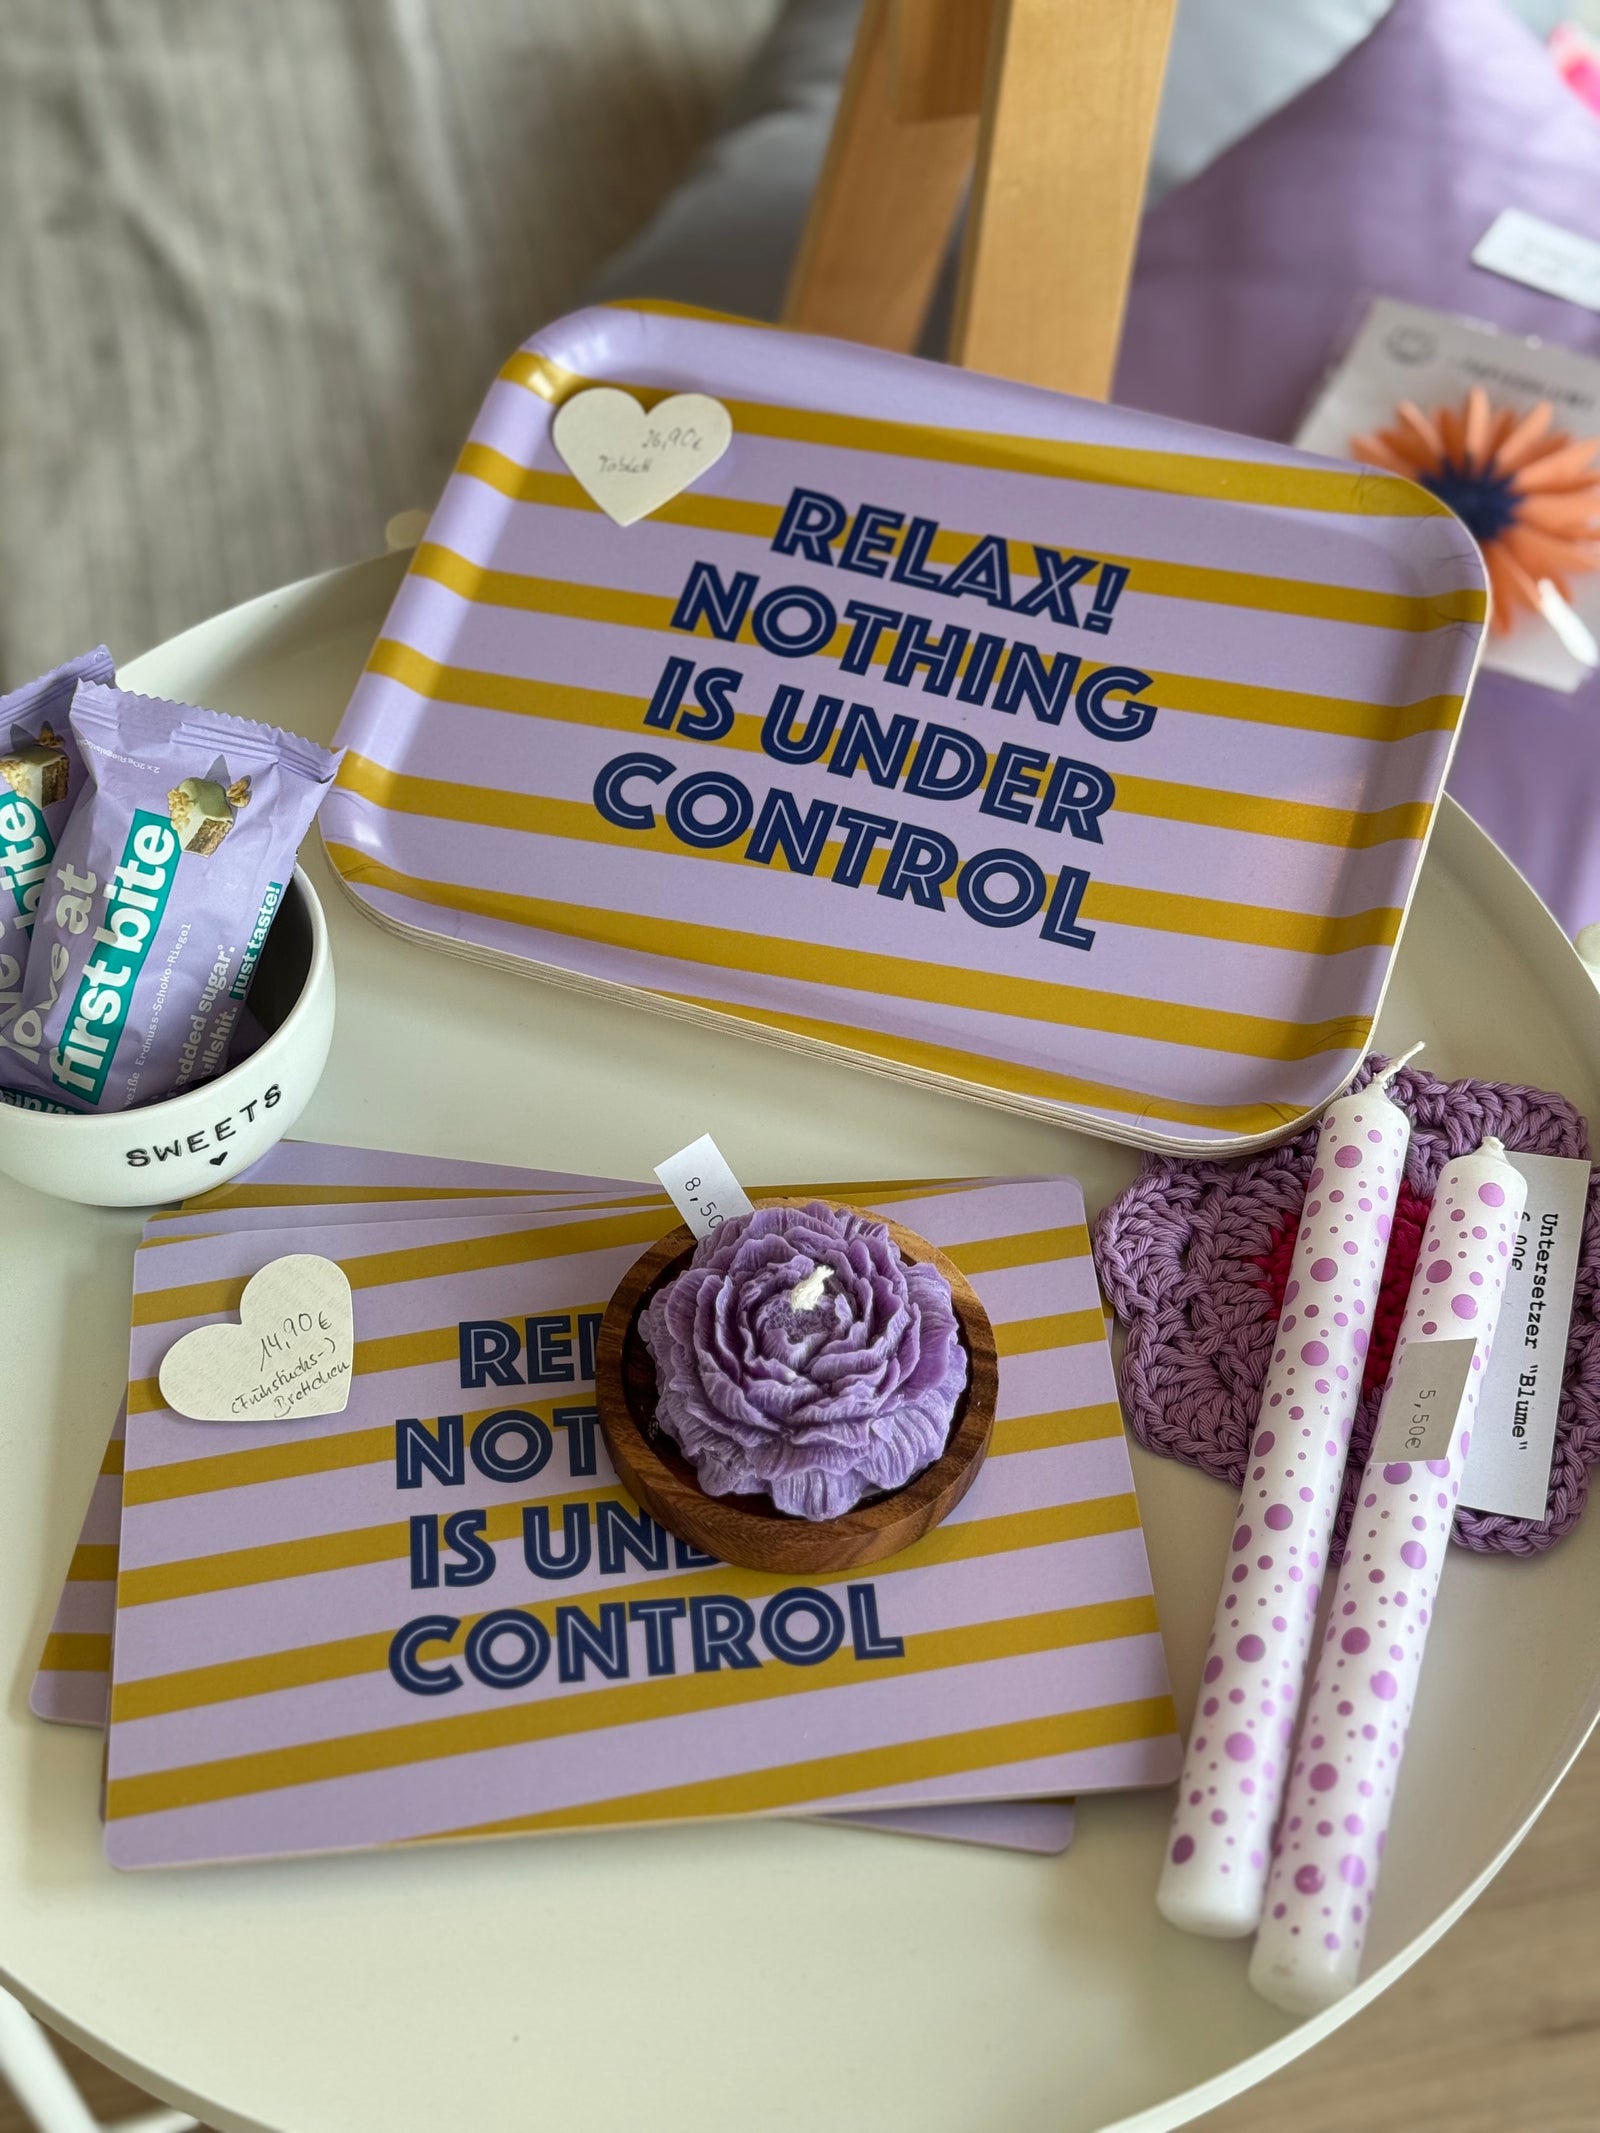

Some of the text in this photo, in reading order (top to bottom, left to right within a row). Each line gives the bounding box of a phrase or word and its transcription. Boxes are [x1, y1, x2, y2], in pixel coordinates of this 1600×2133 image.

[770, 487, 1131, 635] RELAX!
[670, 560, 1158, 742] NOTHING
[643, 656, 1116, 845] IS UNDER
[55, 863, 98, 936] at
[593, 752, 1096, 951] CONTROL
[49, 822, 175, 1092] first bite
[228, 949, 257, 1000] just
[248, 886, 280, 948] taste!
[176, 1014, 208, 1087] added
[126, 1083, 283, 1168] SWEETS
[1523, 1213, 1559, 1349] Untersetzer
[1405, 1389, 1436, 1450] 5,50€
[410, 1509, 496, 1590] IS
[388, 1583, 906, 1697] CONTROL
